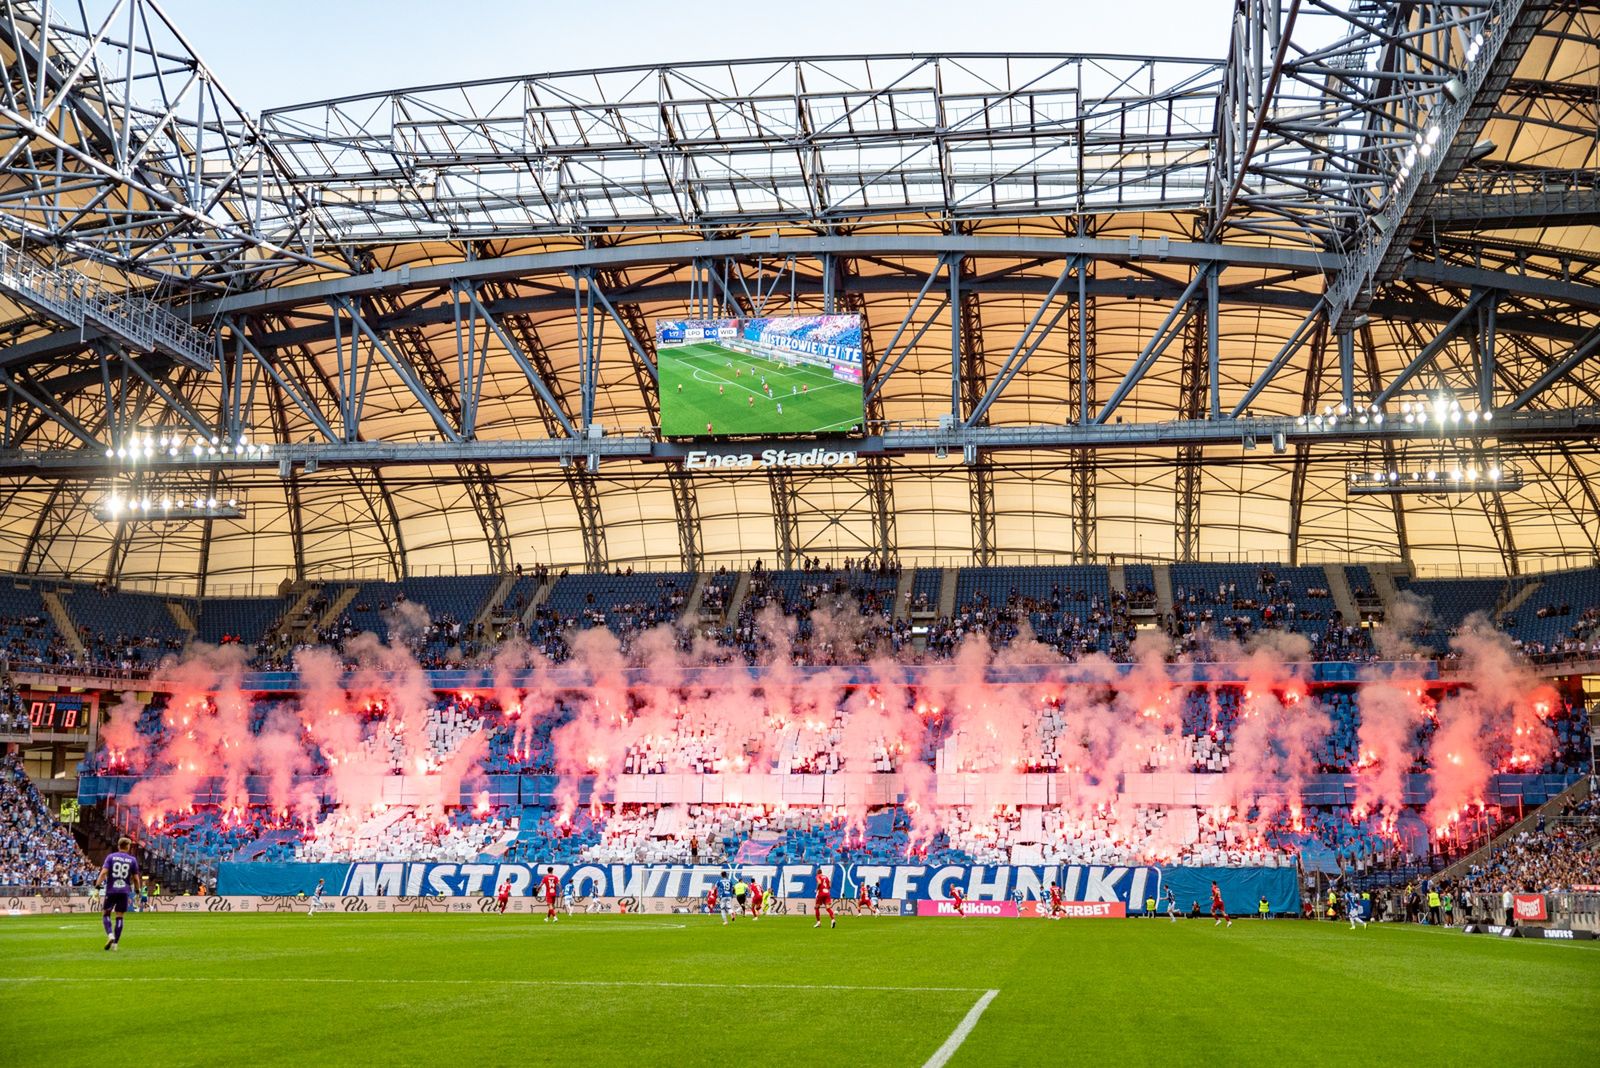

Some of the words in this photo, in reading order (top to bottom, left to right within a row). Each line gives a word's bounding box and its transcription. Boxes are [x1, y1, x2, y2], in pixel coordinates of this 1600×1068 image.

[760, 333, 818, 354] MISTRZOWIE
[686, 451, 753, 468] Enea
[761, 448, 856, 466] Stadion
[112, 861, 130, 879] 98
[347, 862, 723, 897] MISTRZOWIE
[856, 865, 1148, 910] TECHNIKI
[205, 895, 233, 912] Pils
[341, 896, 369, 912] Pils
[477, 896, 501, 913] Pil
[1035, 903, 1110, 916] SERBET
